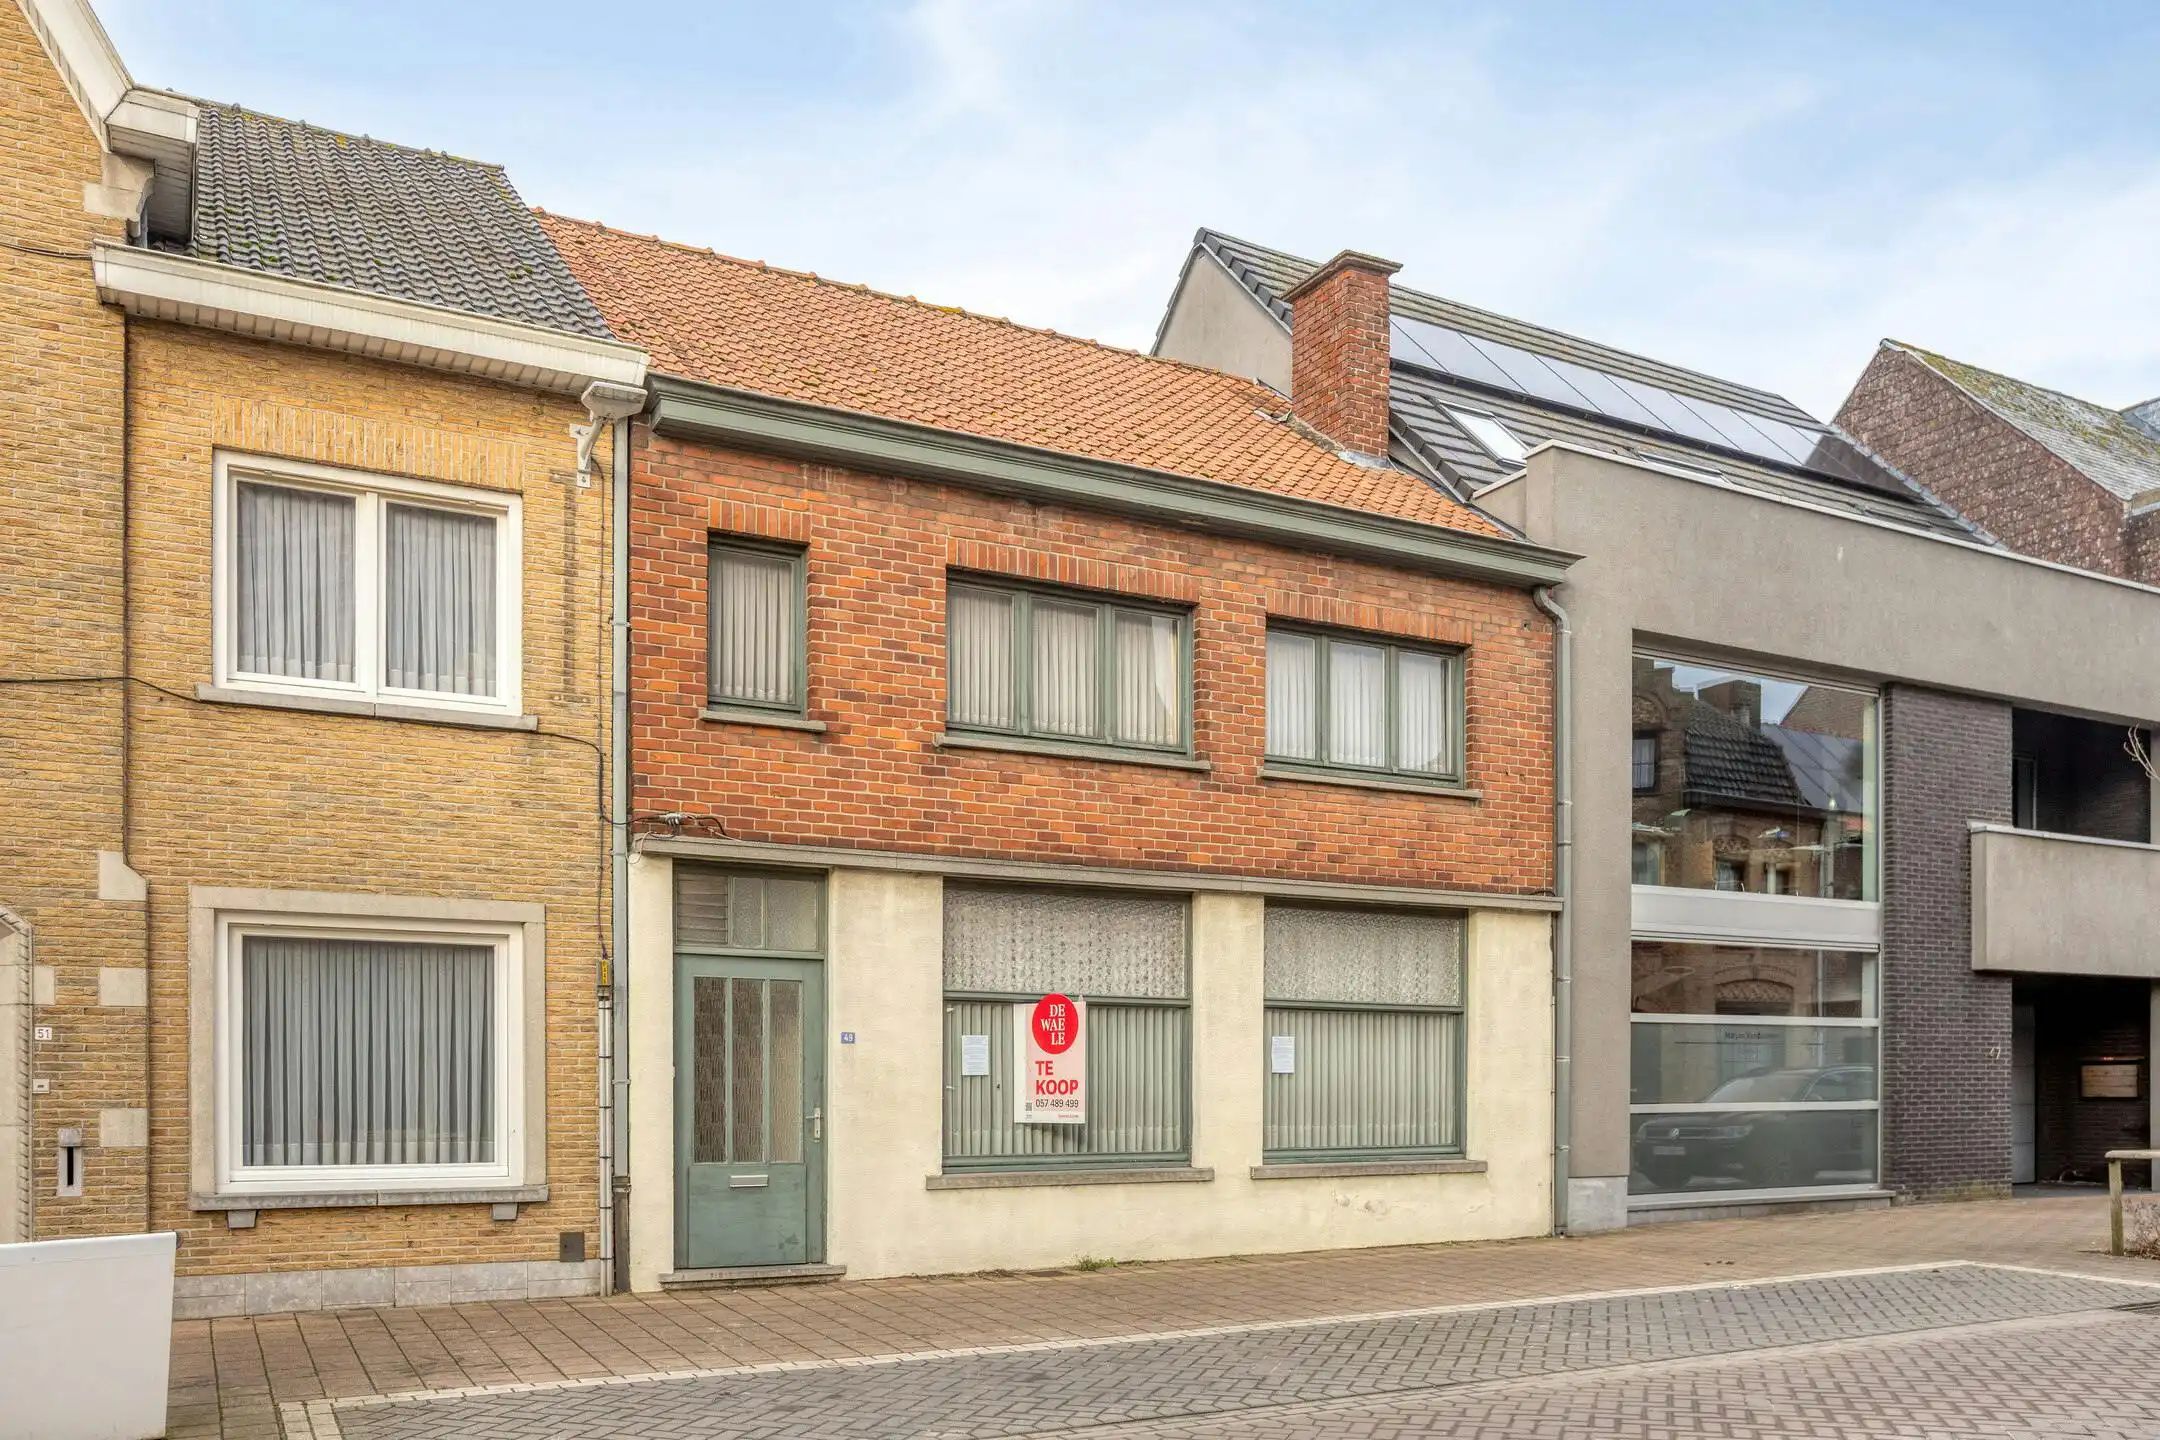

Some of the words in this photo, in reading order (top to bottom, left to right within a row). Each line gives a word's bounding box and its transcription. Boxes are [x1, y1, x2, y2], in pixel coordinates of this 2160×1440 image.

[1049, 1004, 1066, 1018] DE
[1040, 1018, 1066, 1032] WAE
[38, 1028, 49, 1039] 51
[1051, 1032, 1066, 1046] LE
[1035, 1060, 1054, 1076] TE
[1035, 1079, 1079, 1096] KOOP
[1035, 1099, 1049, 1108] 057
[1050, 1099, 1064, 1108] 489
[1065, 1099, 1079, 1108] 499
